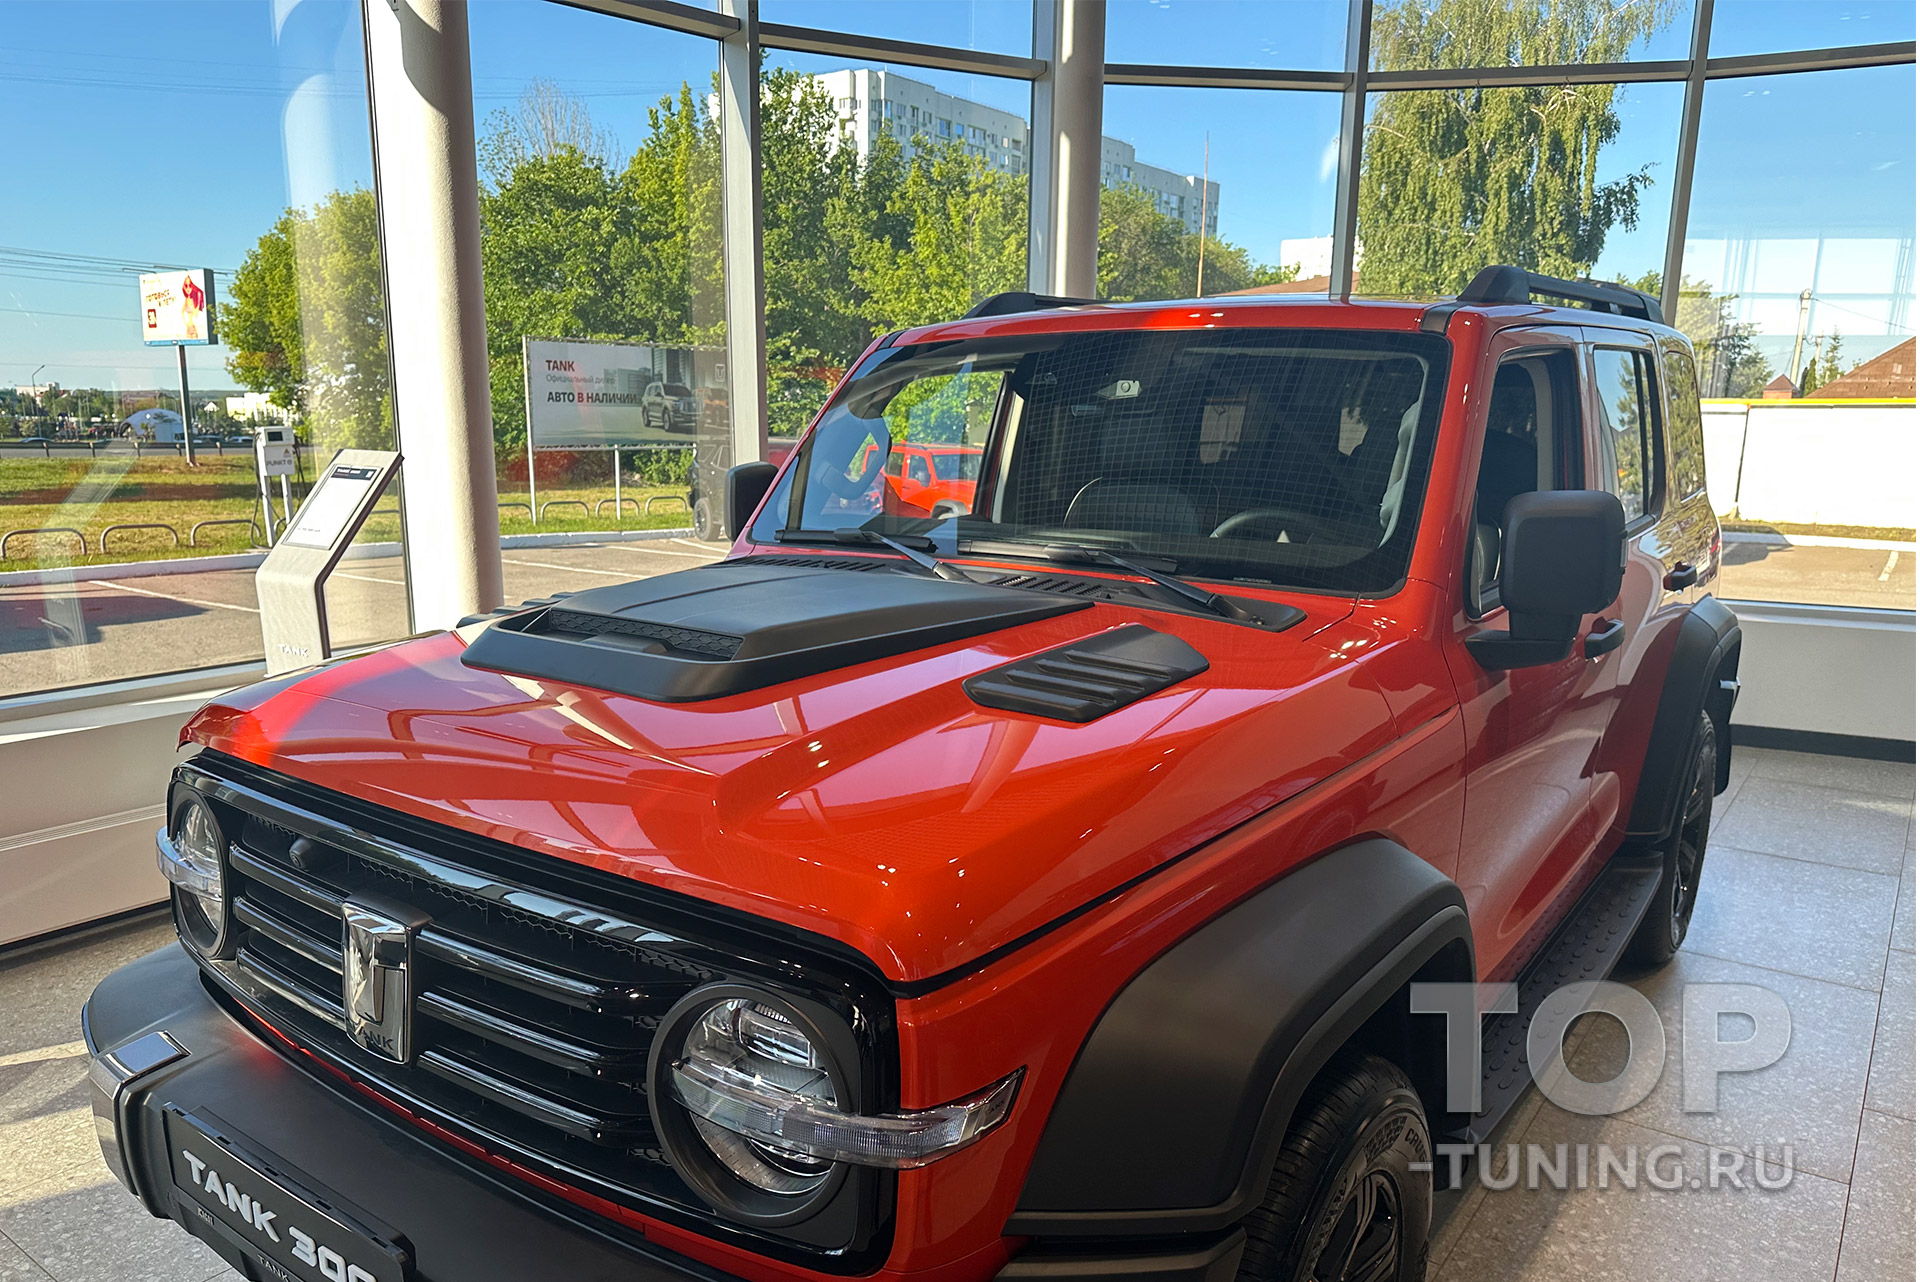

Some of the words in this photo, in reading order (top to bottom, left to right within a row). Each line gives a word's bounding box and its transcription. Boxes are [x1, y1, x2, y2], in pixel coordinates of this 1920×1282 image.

[545, 359, 575, 372] TANK
[547, 391, 575, 403] АВТО
[577, 392, 585, 403] В
[586, 392, 637, 405] НАЛИЧИИ
[277, 643, 309, 658] TANK
[182, 1149, 281, 1244] TANK
